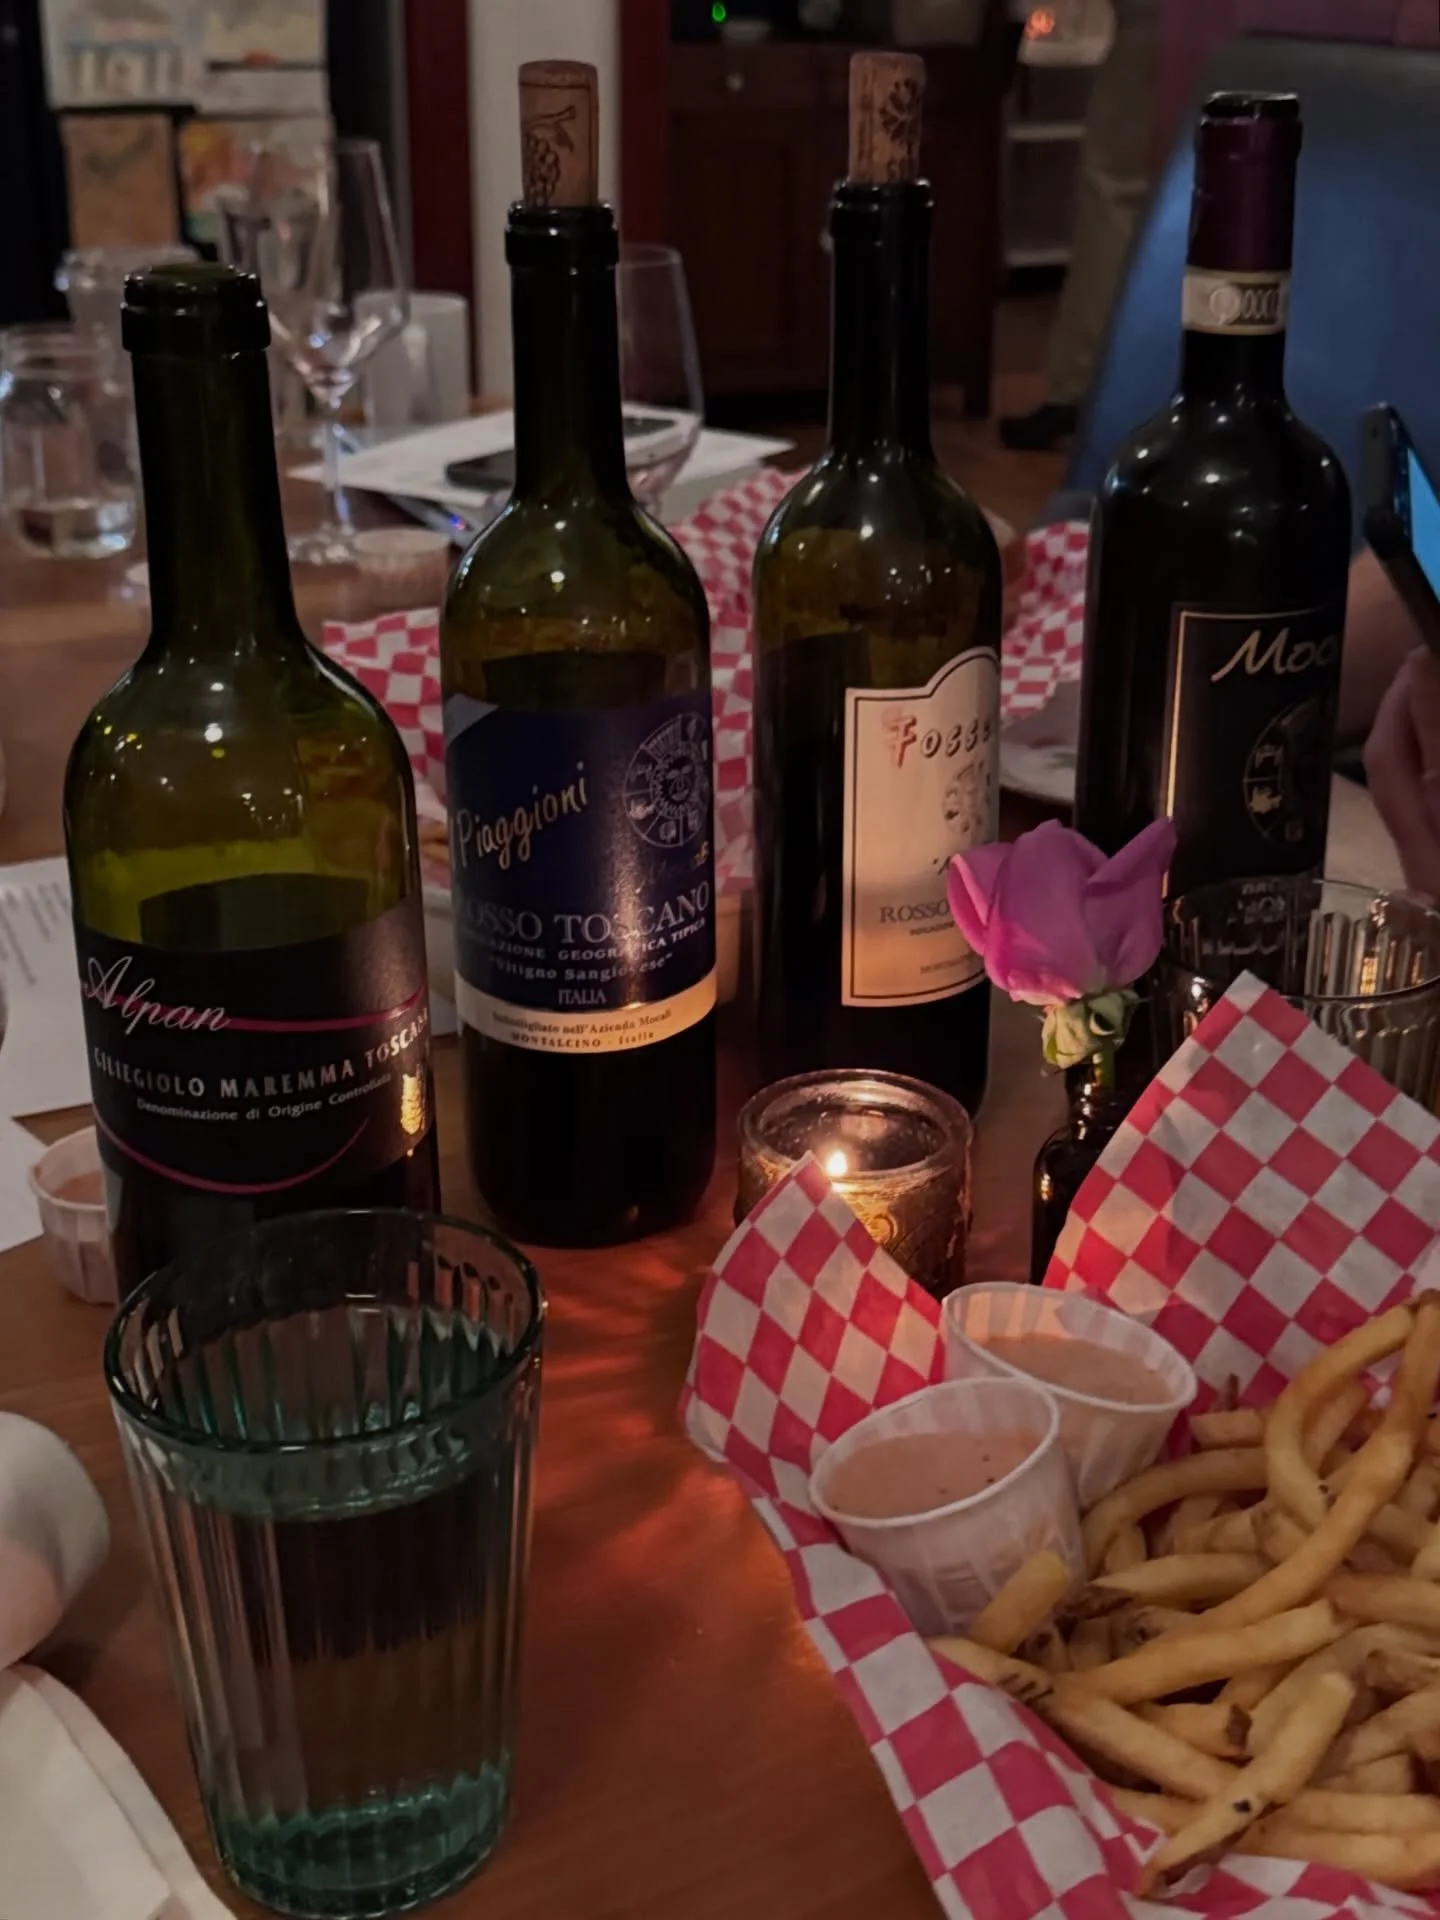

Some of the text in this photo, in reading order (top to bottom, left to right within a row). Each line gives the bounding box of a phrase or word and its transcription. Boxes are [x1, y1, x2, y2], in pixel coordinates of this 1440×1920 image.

[457, 760, 588, 870] Piaggioni
[458, 880, 710, 944] OSSO TOSCANO
[880, 898, 951, 923] ROSSO
[558, 937, 667, 961] GEOGRICA
[83, 955, 232, 1036] Alpan
[558, 989, 606, 1006] ITALIA
[511, 1031, 602, 1049] MONTALCINO
[220, 1058, 355, 1099] MAREMMA
[137, 1098, 239, 1121] Denominazione
[246, 1107, 260, 1120] di
[268, 1099, 322, 1119] Origine
